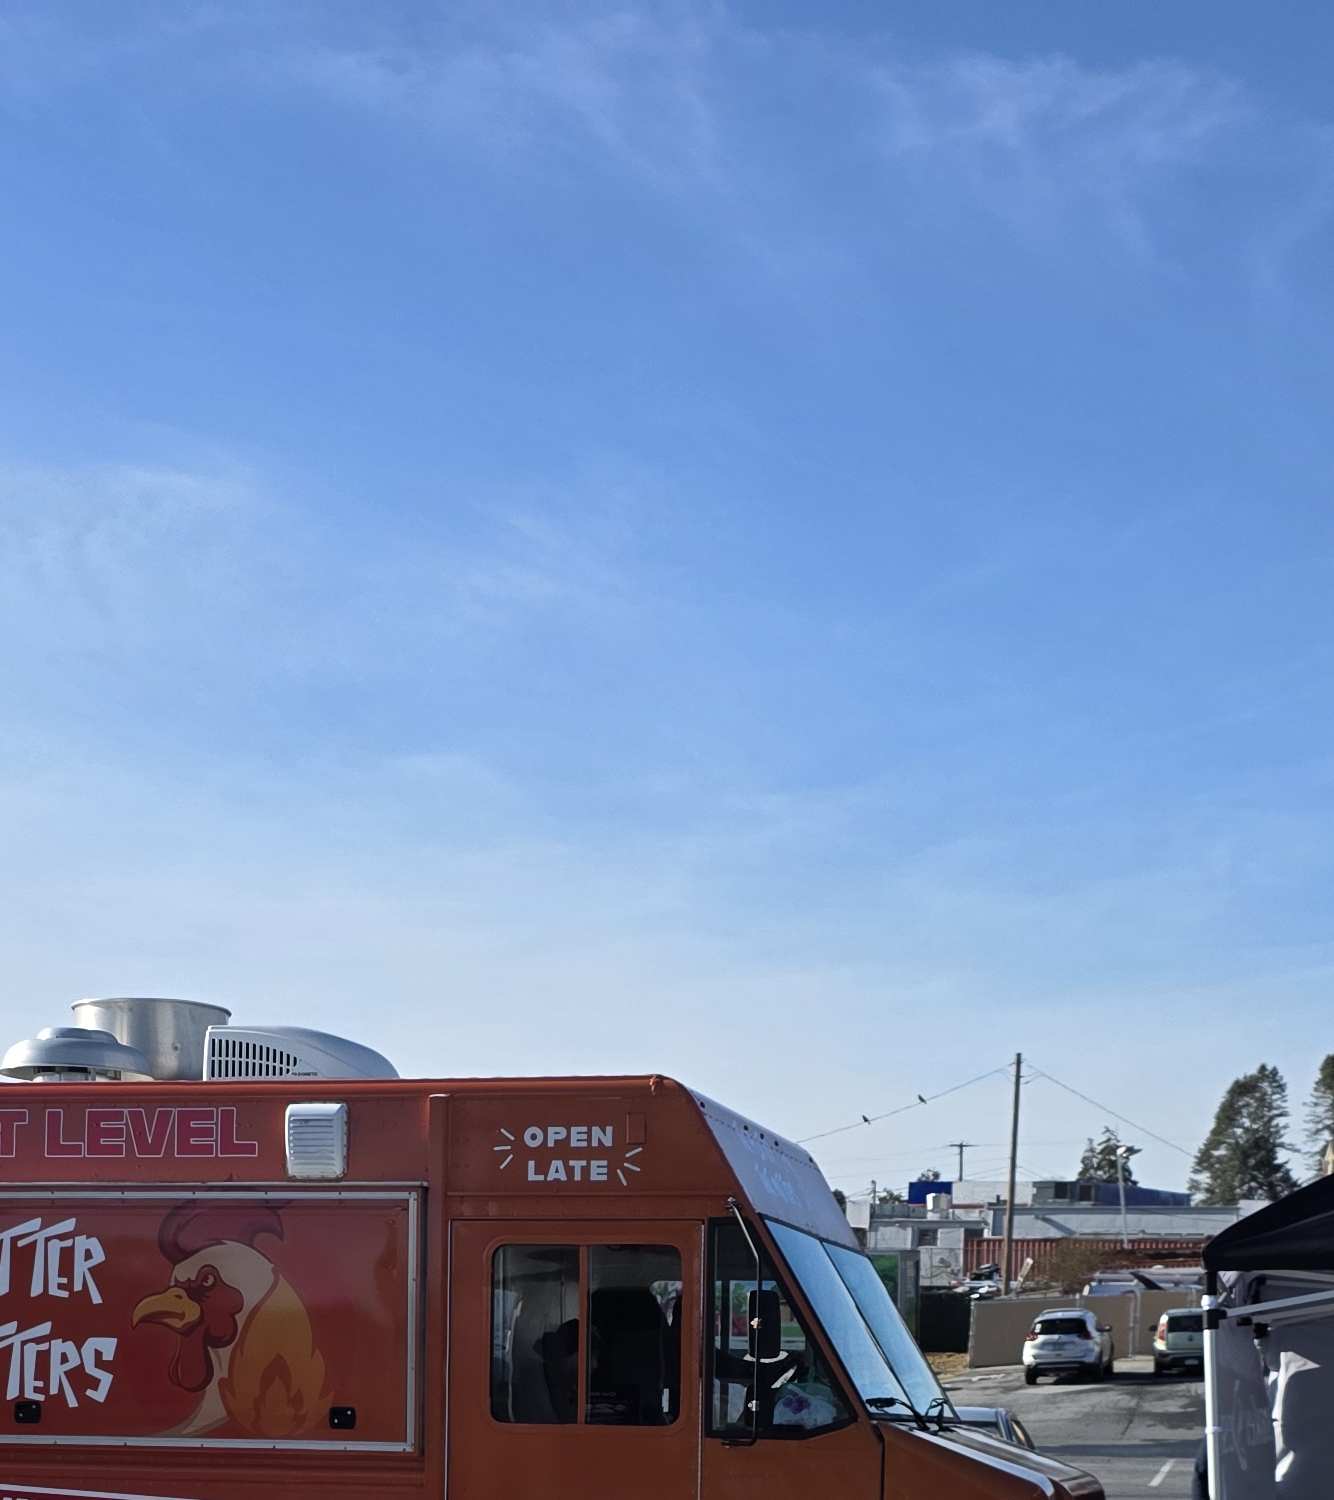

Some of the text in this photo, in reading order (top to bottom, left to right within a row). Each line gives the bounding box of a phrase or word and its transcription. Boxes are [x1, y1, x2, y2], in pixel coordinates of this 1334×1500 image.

[44, 1107, 258, 1158] LEVEL
[523, 1126, 614, 1149] OPEN
[527, 1159, 609, 1182] LATE
